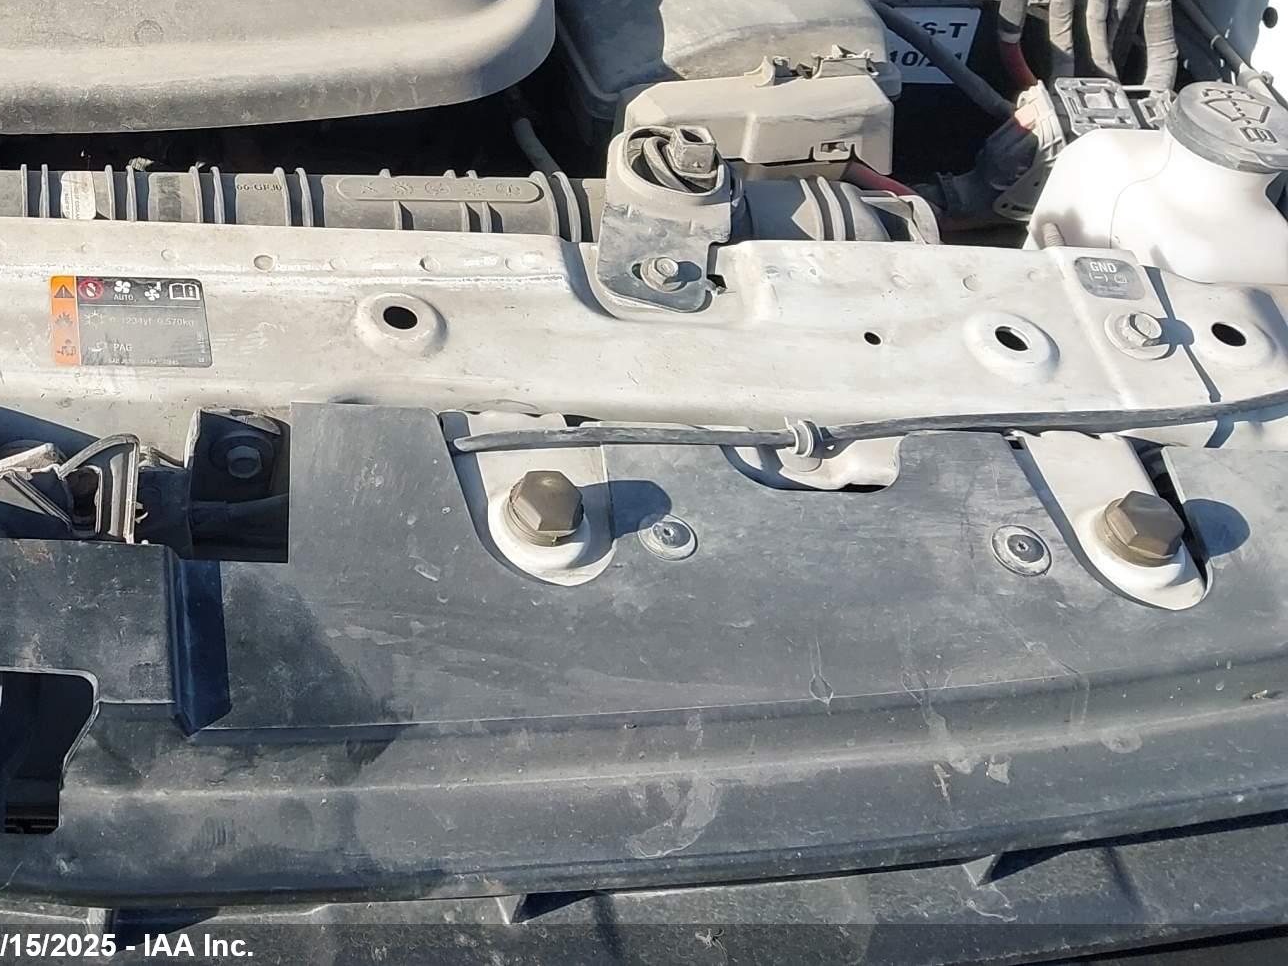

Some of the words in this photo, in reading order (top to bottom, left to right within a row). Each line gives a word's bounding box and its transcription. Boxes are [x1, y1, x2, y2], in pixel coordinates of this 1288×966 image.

[1089, 261, 1117, 273] GND
[113, 293, 134, 301] AUTO
[113, 343, 132, 352] PAG
